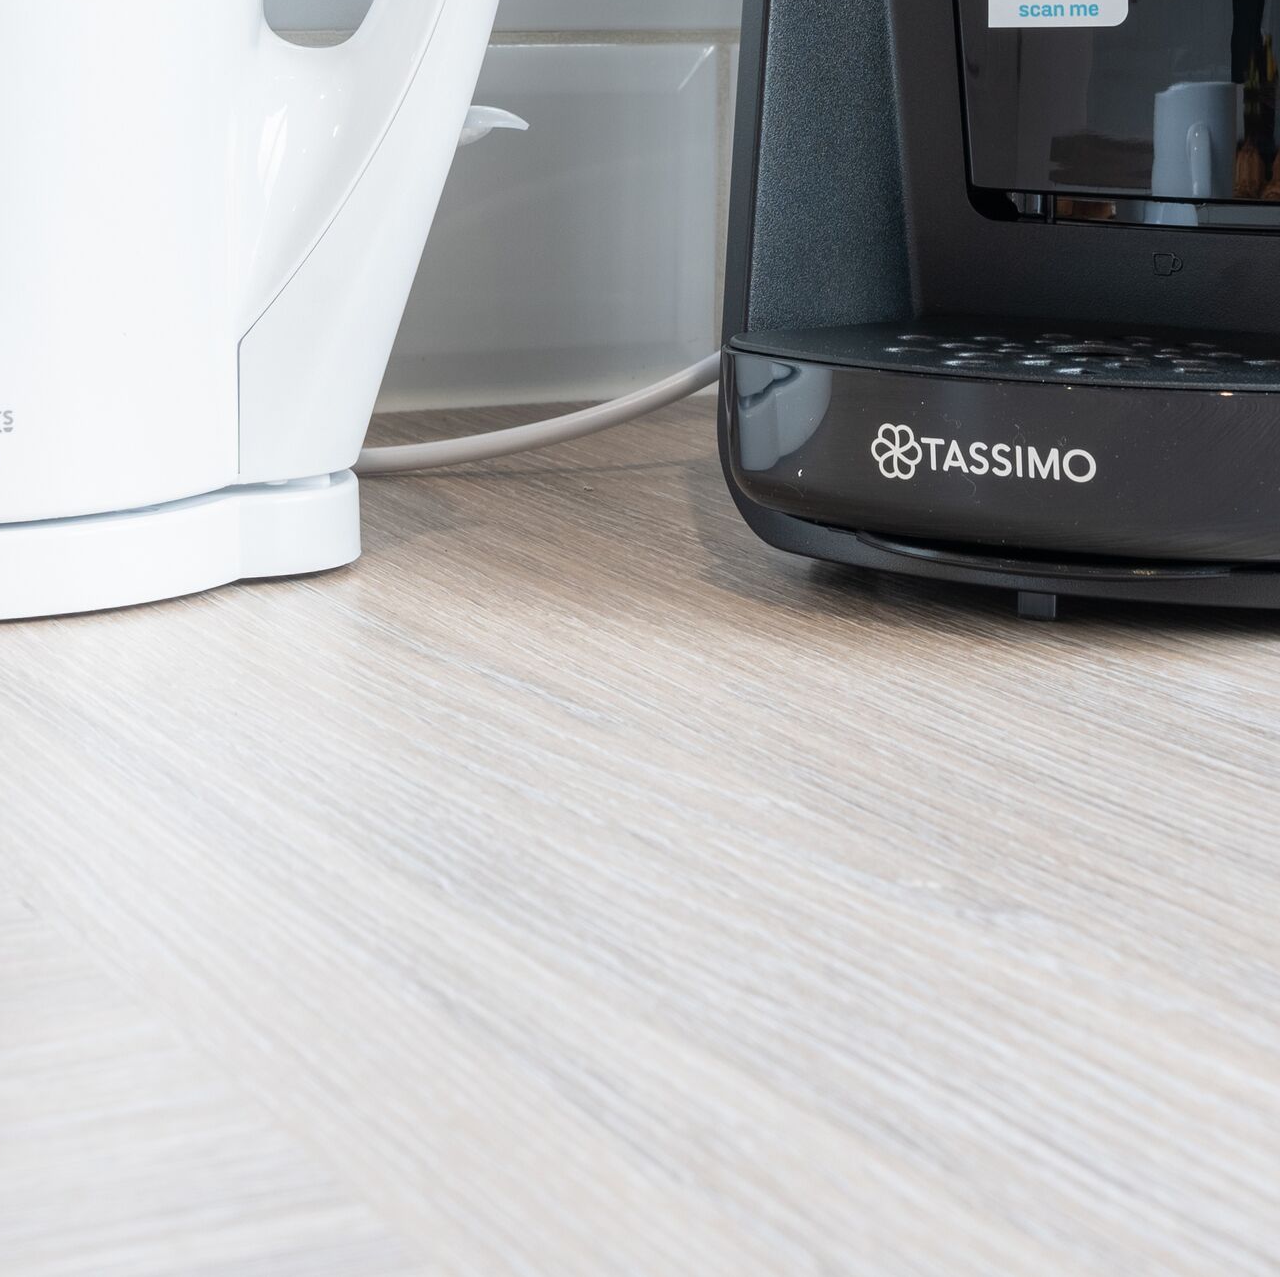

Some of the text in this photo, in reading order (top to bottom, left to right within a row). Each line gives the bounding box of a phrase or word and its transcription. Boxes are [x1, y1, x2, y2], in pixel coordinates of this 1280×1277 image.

[1019, 3, 1099, 17] scan me
[920, 437, 1097, 483] TASSIMO
